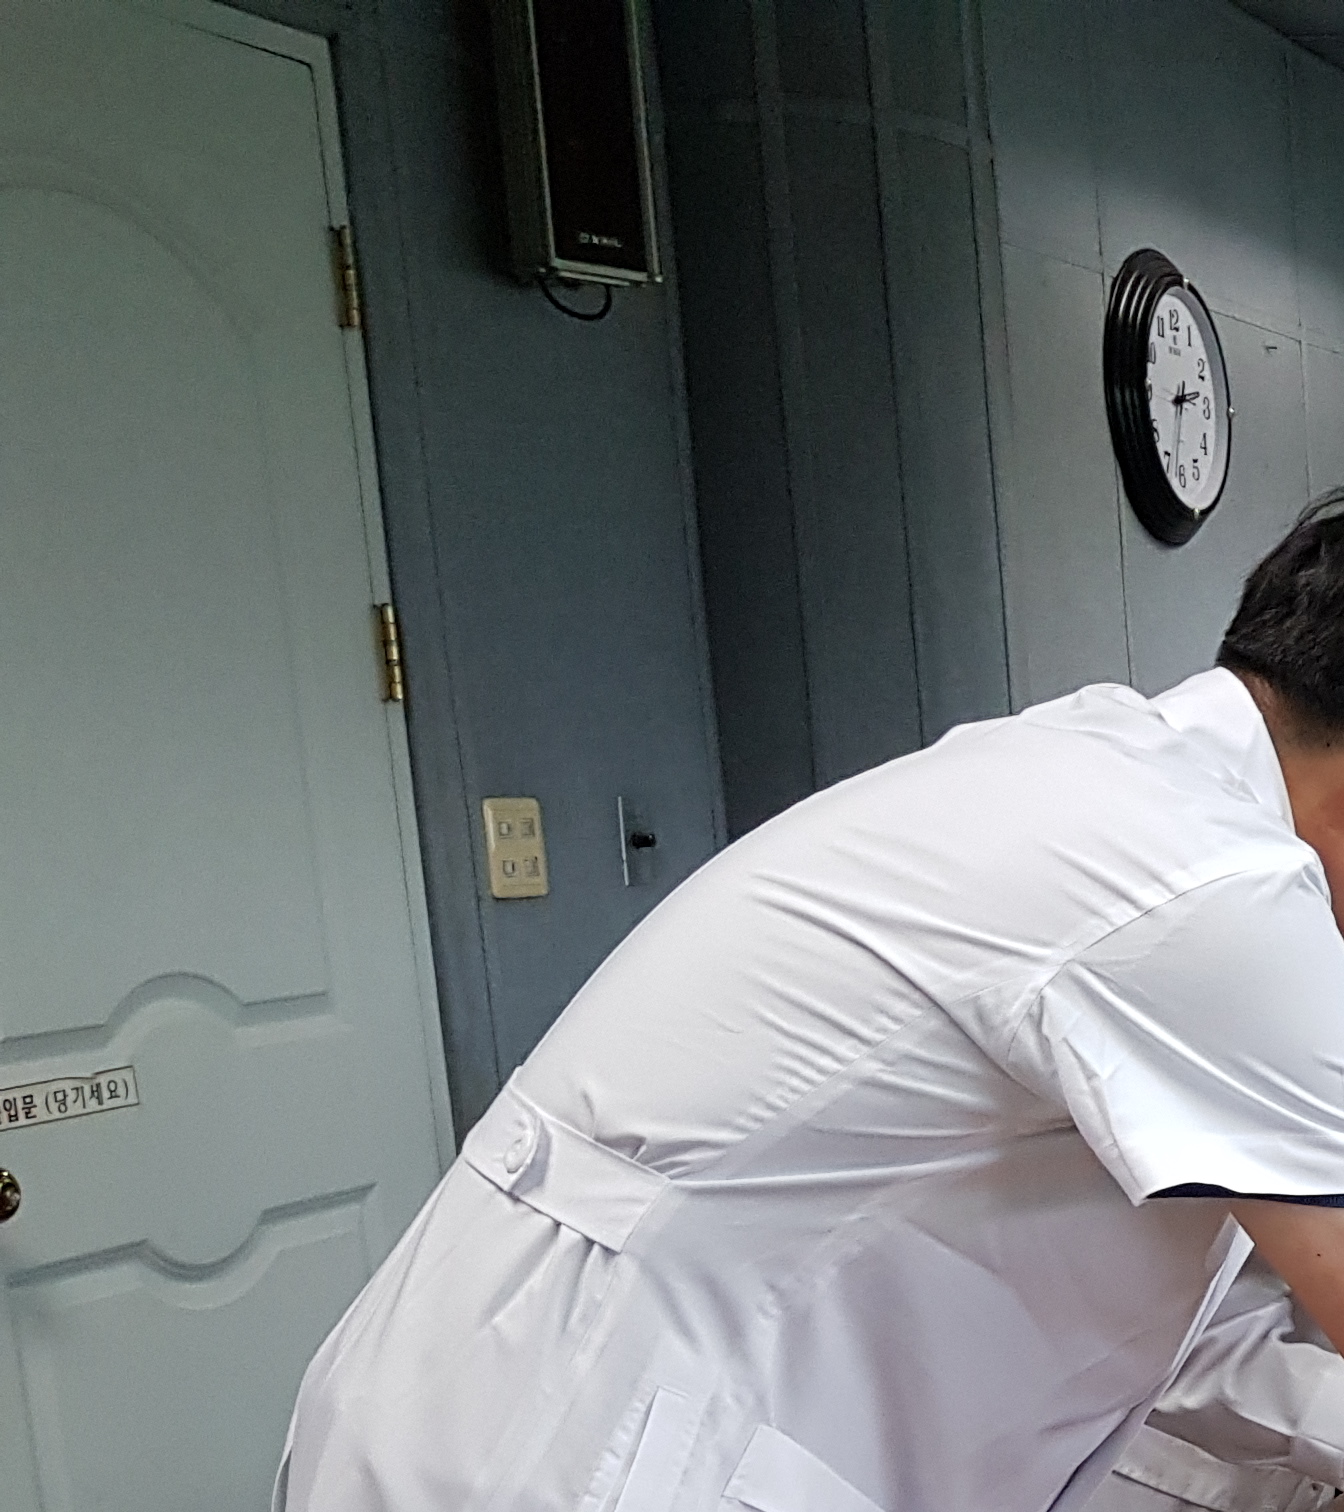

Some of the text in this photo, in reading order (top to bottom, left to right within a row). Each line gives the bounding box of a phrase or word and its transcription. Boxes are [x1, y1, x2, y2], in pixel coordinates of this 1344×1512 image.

[1169, 309, 1180, 332] 12
[1187, 324, 1192, 347] 1
[1197, 358, 1205, 381] 2
[1203, 397, 1211, 420] 3
[1200, 433, 1208, 456] 4
[1163, 451, 1171, 473] 7
[1192, 458, 1200, 481] 5
[1178, 464, 1187, 488] 6
[0, 1078, 129, 1122] 입문 (당기세요)
